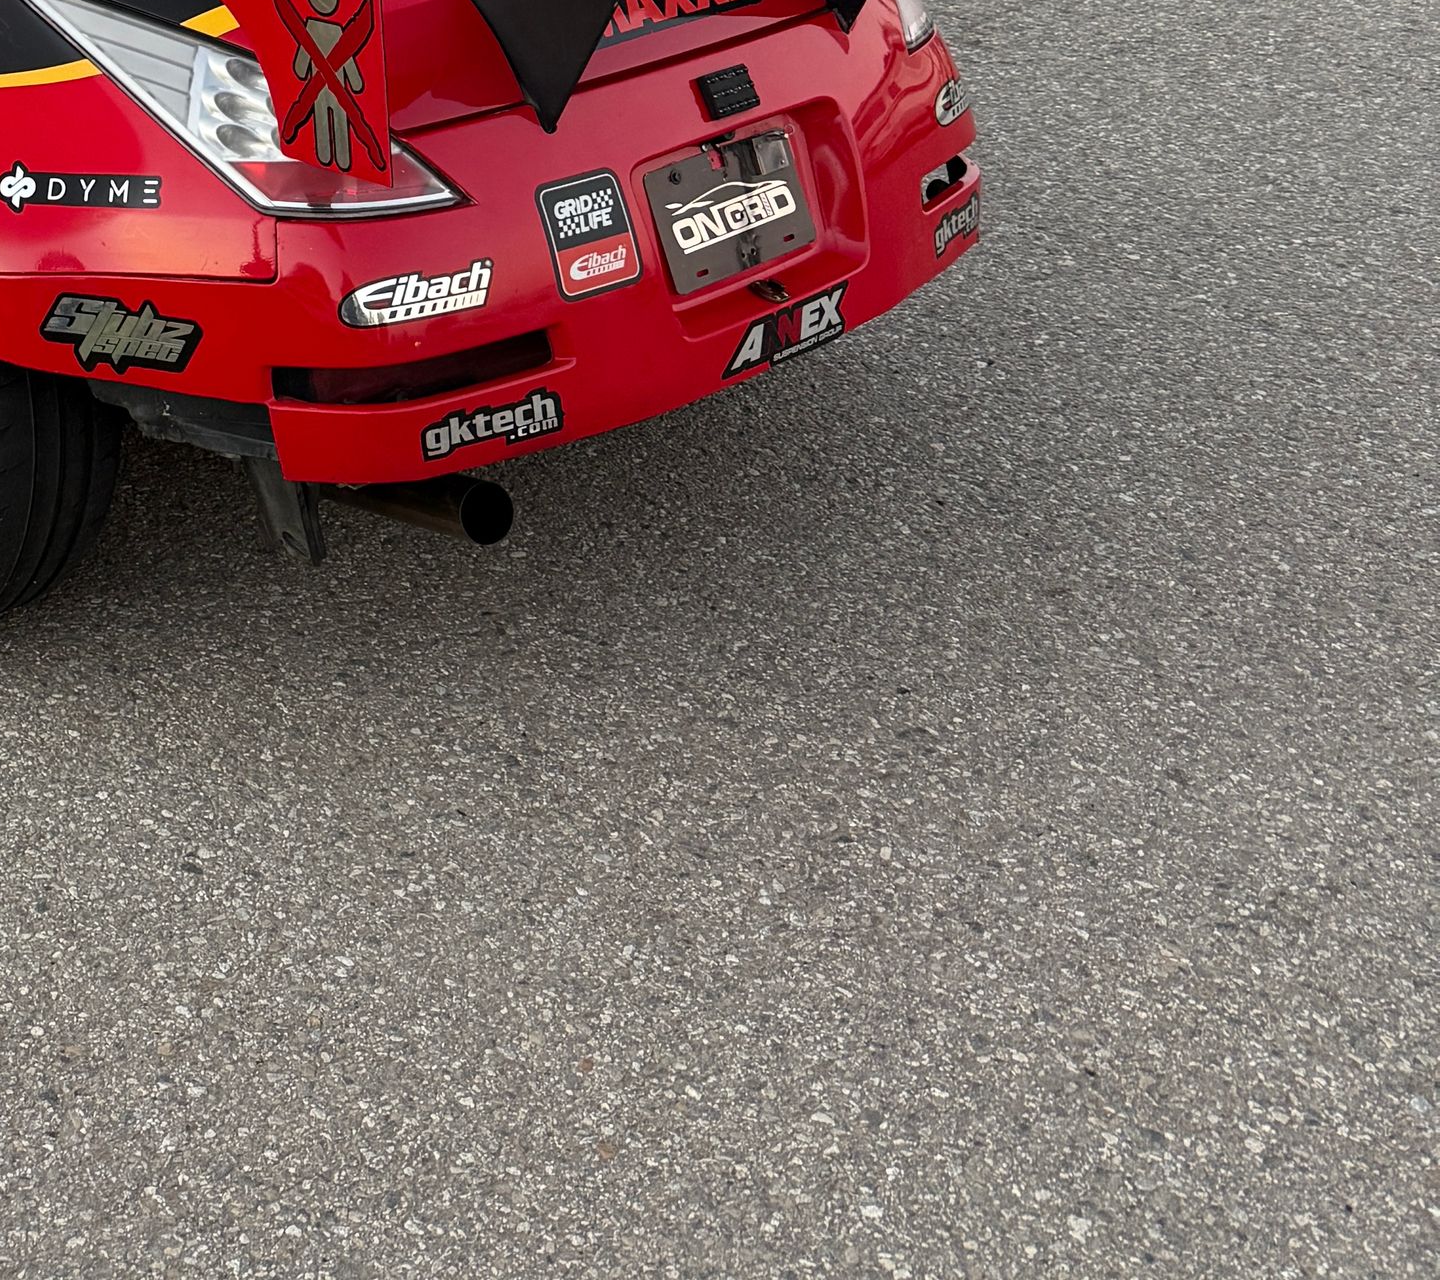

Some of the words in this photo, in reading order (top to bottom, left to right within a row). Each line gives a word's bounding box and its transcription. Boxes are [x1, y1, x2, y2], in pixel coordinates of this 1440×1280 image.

[48, 178, 159, 204] DYME
[554, 194, 593, 219] GRID
[580, 207, 613, 232] LIFE
[935, 197, 978, 255] gktech
[569, 244, 627, 276] Eibach
[350, 261, 491, 315] Eibach
[773, 335, 818, 362] SUSPENSION
[819, 324, 843, 341] GROUP
[425, 393, 557, 457] gktech
[510, 416, 559, 440] .com
